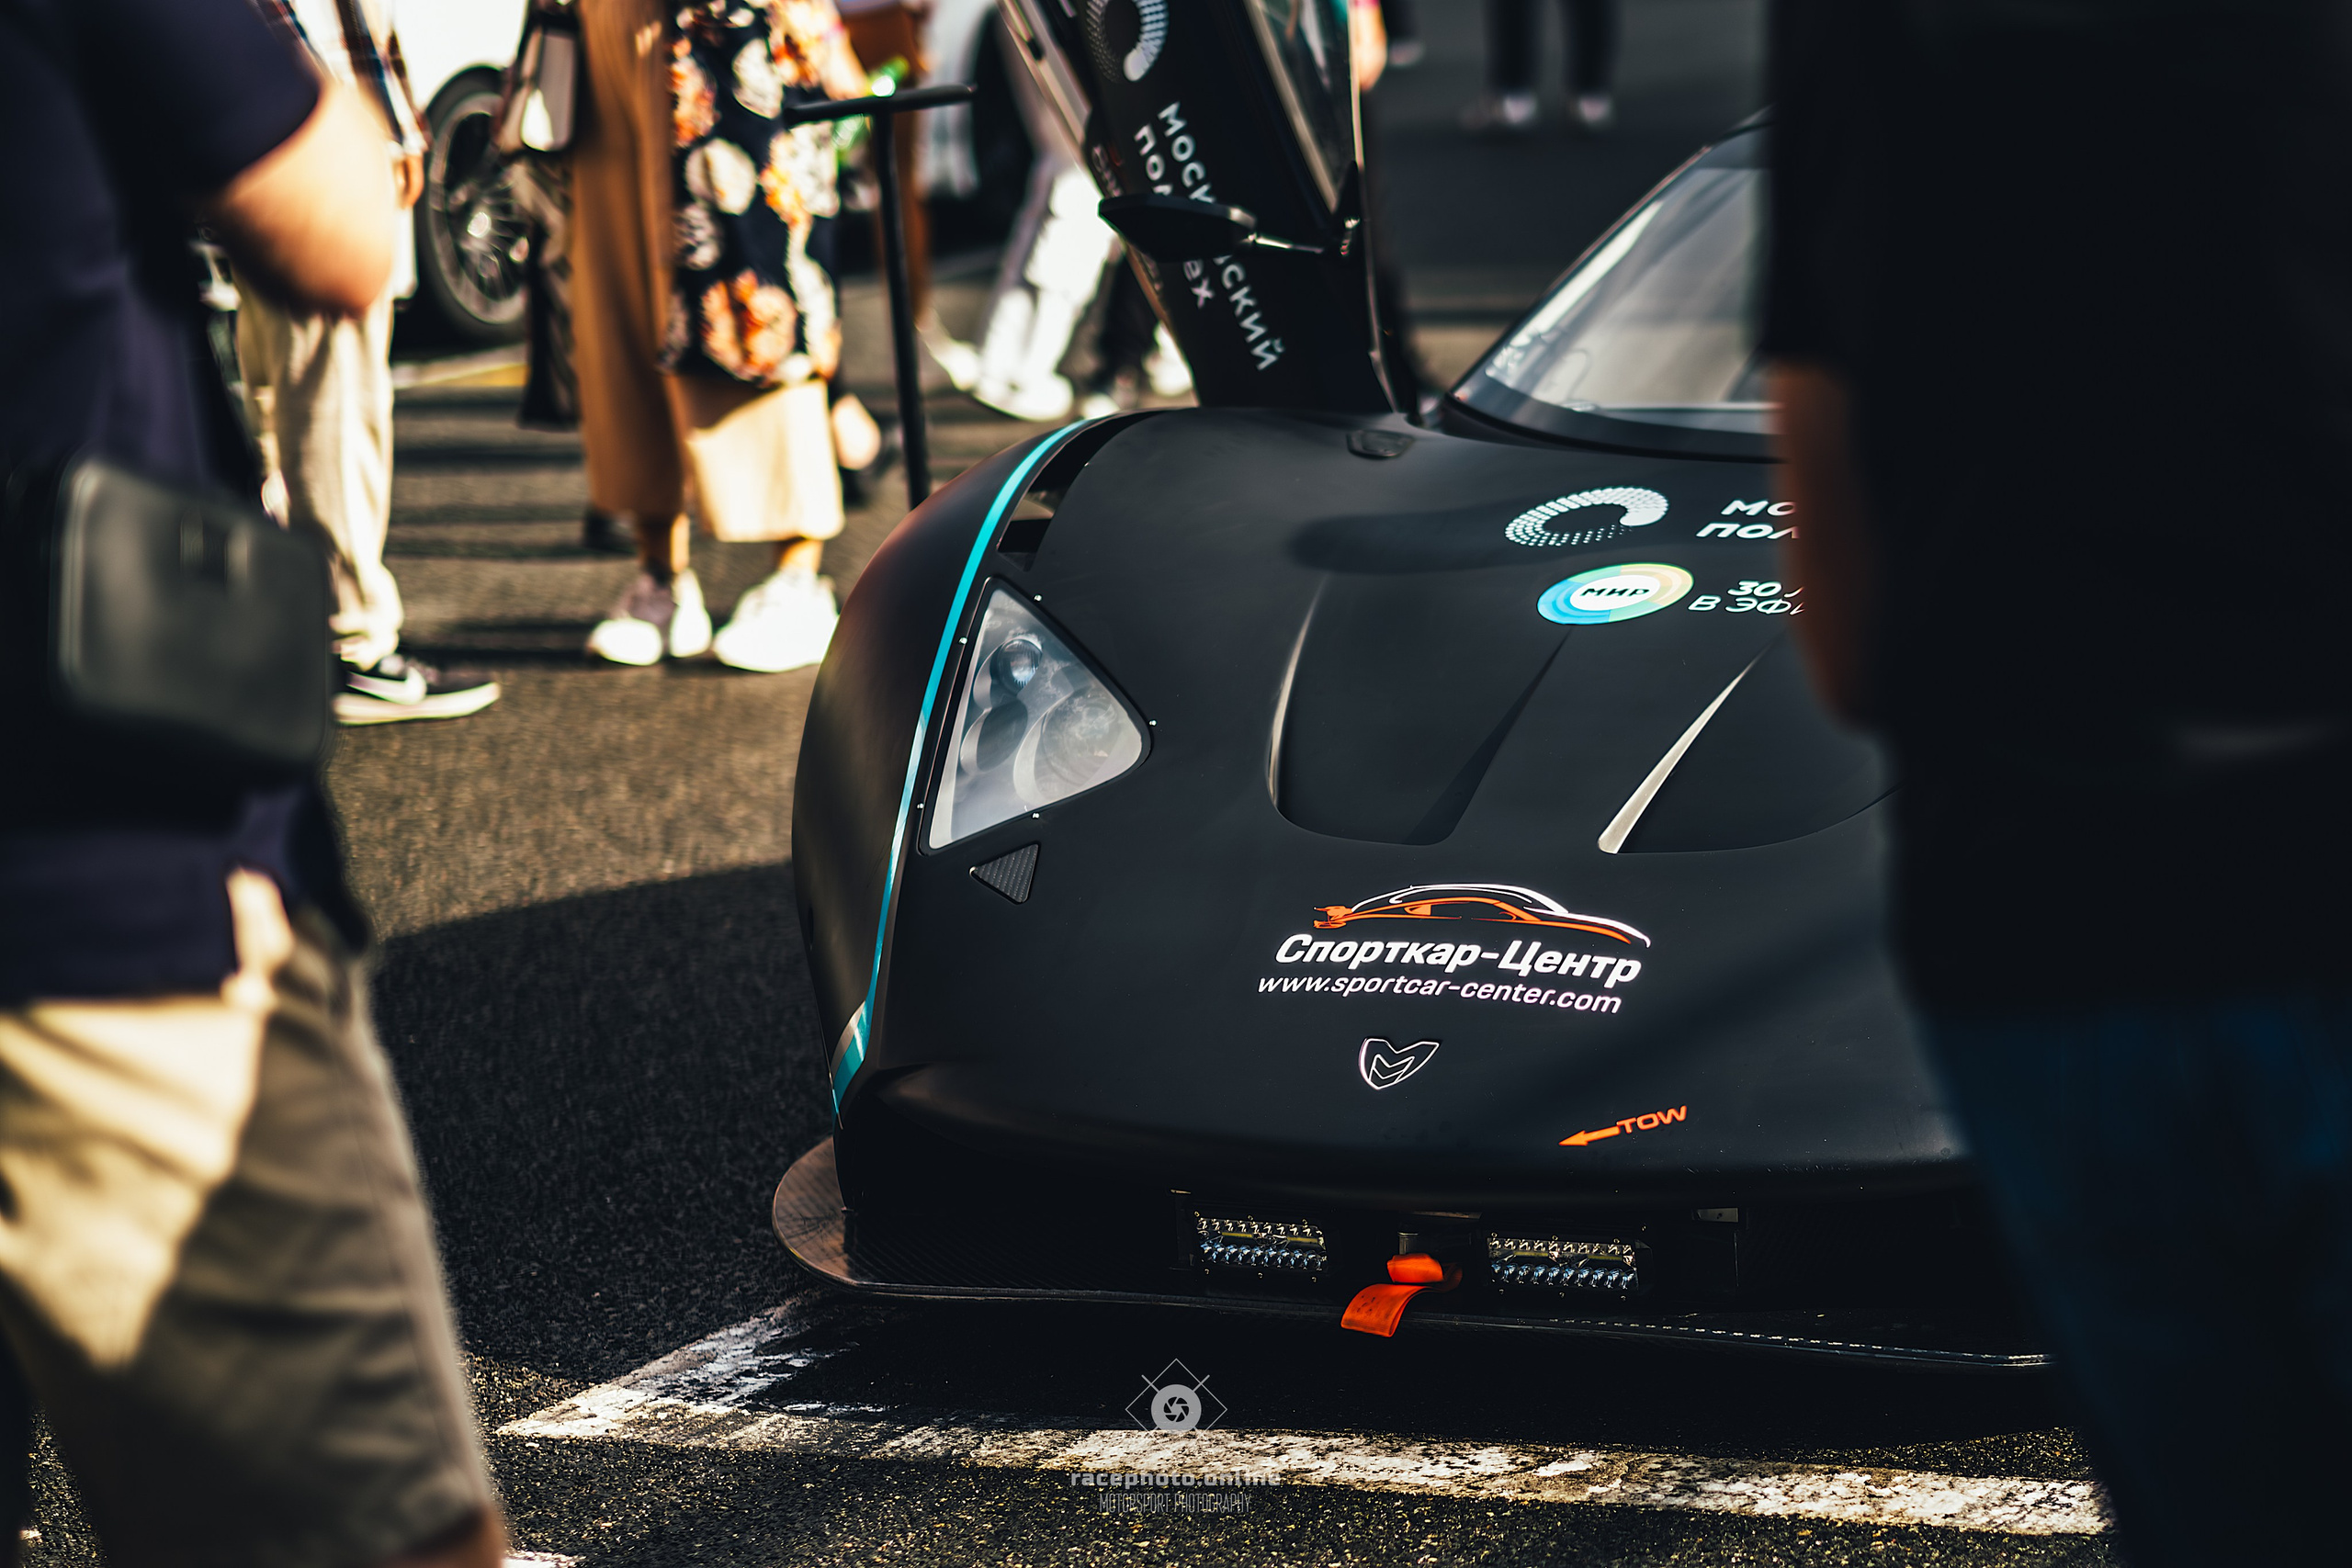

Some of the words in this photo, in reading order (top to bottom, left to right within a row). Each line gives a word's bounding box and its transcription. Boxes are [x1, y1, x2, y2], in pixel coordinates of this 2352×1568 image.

[1158, 101, 1285, 370] МОСКСКИЙ
[1579, 588, 1650, 597] МИР
[1688, 595, 1722, 611] В
[1275, 933, 1642, 987] Спорткар-Центр
[1258, 975, 1622, 1013] www.sportcar-center.com
[1617, 1105, 1687, 1133] TOW
